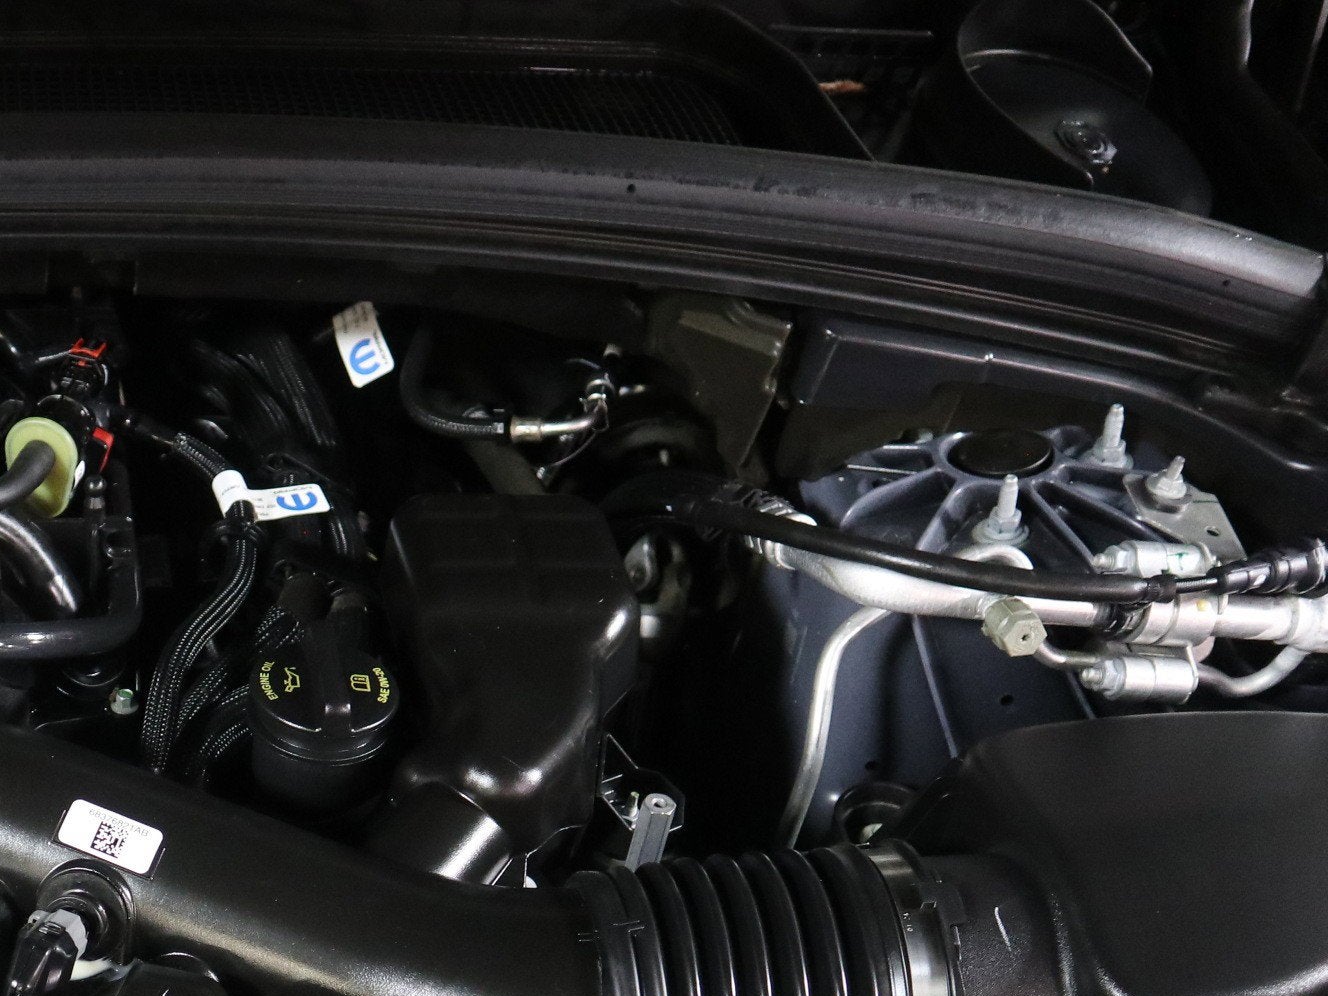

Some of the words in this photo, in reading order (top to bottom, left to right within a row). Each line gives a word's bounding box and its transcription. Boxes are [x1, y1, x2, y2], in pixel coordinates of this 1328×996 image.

[262, 661, 275, 672] OIL
[260, 673, 278, 700] ENGINE
[377, 688, 390, 703] SAE
